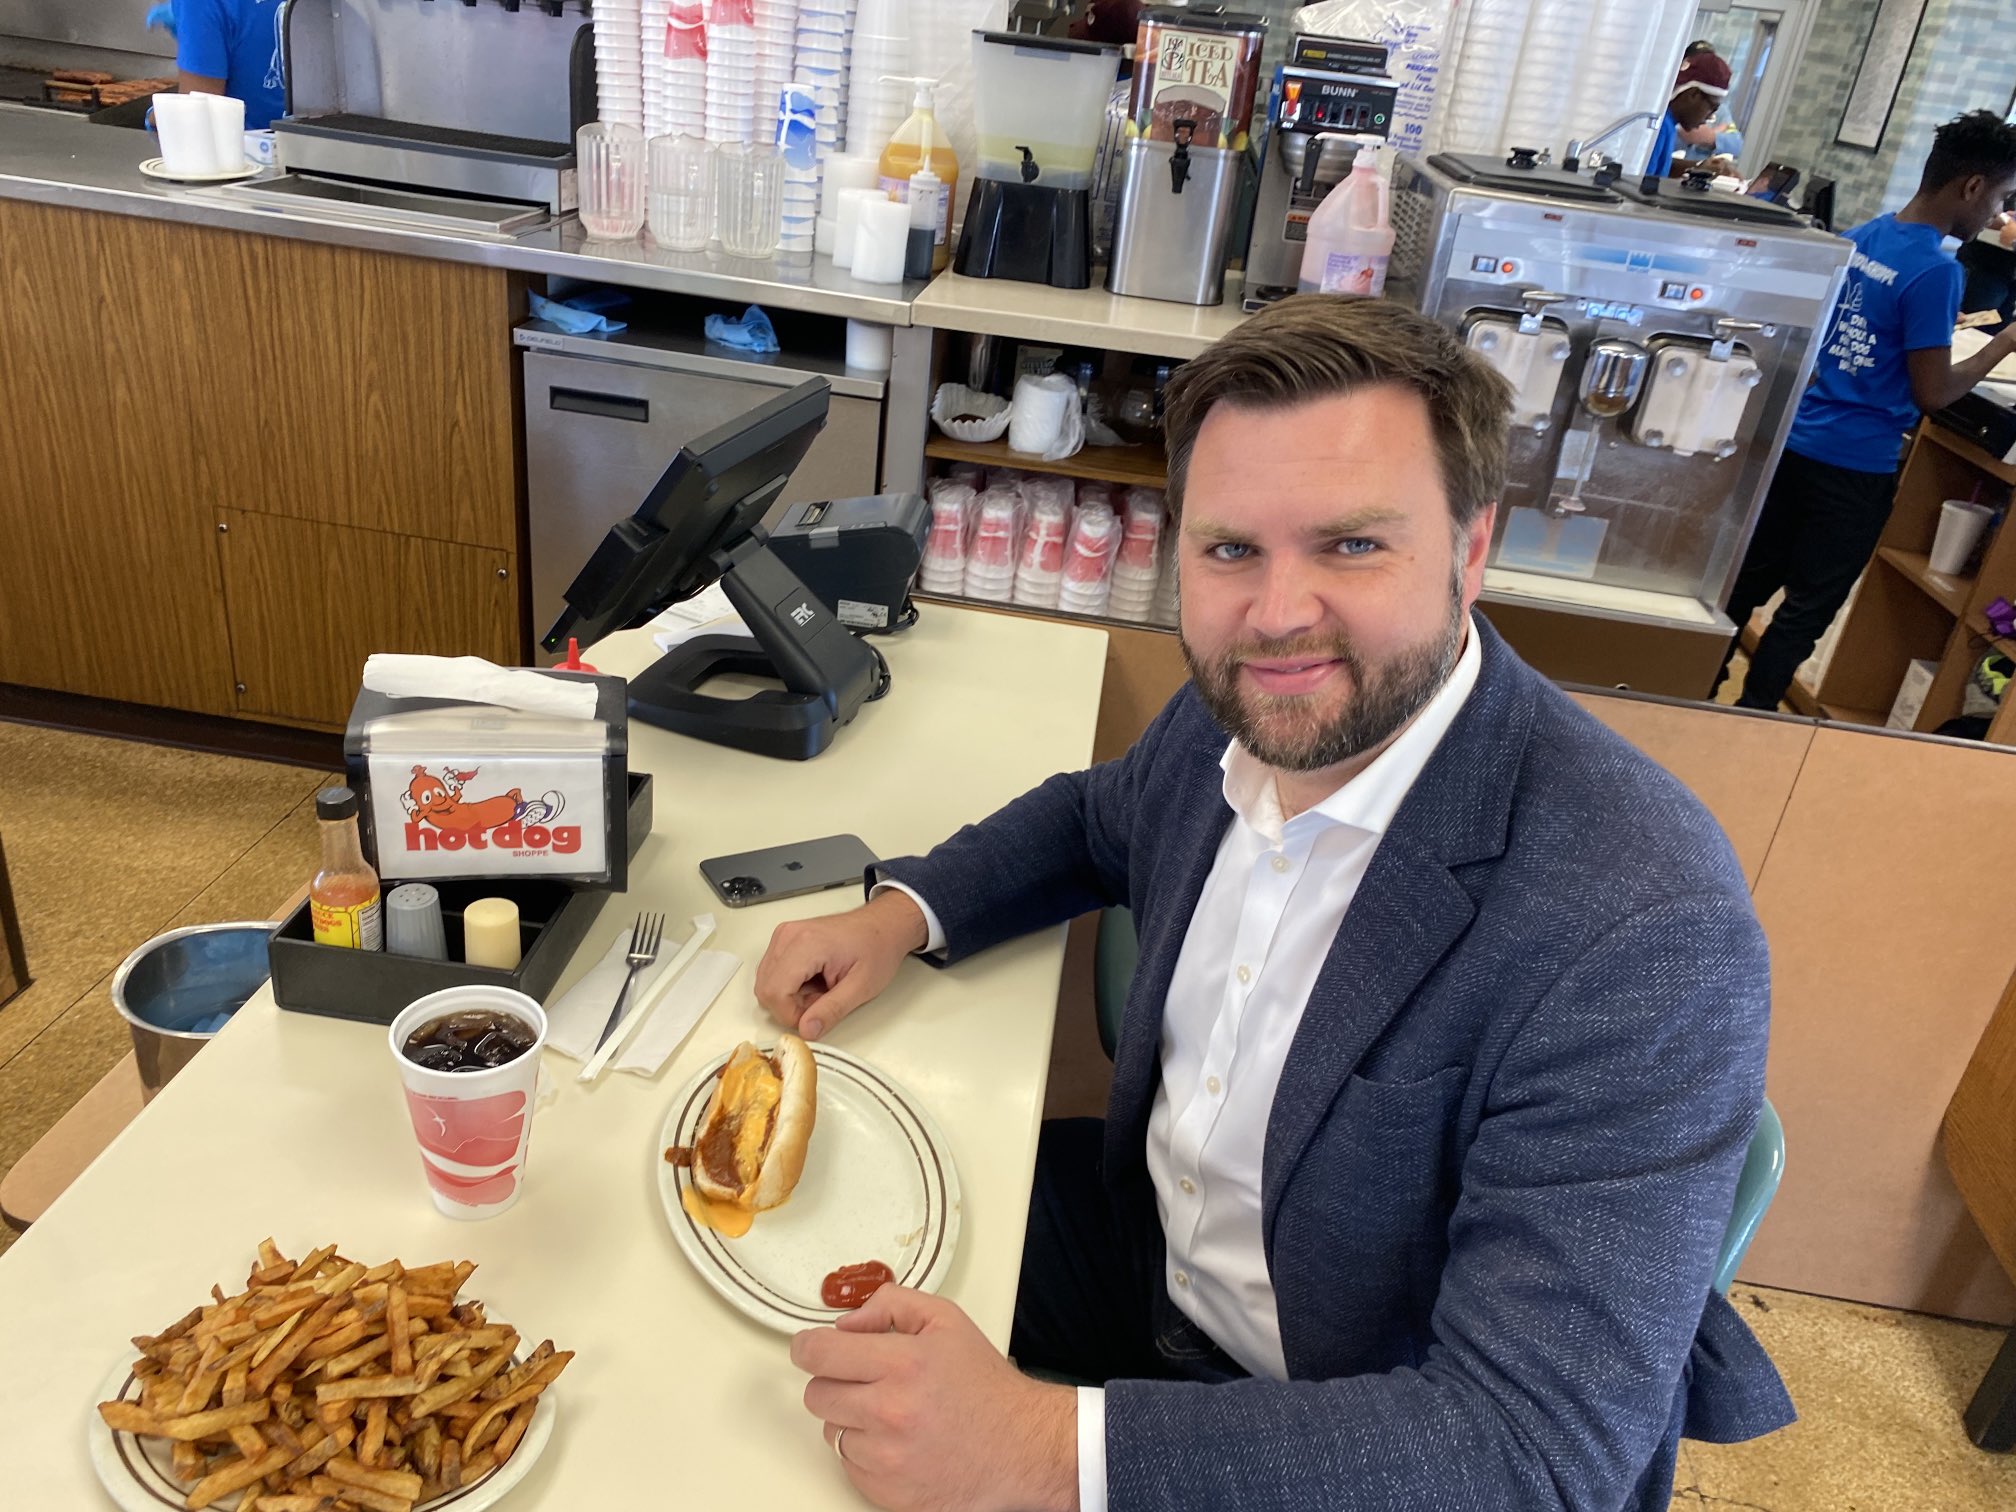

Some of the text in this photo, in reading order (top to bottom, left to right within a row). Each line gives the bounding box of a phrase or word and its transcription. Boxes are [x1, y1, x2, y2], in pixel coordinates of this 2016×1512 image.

[1187, 42, 1234, 61] ICED
[1184, 57, 1229, 88] TEA
[1321, 84, 1357, 98] BUNN
[1404, 122, 1424, 135] 100
[404, 819, 582, 855] hot dog
[512, 850, 550, 858] SHOPPE
